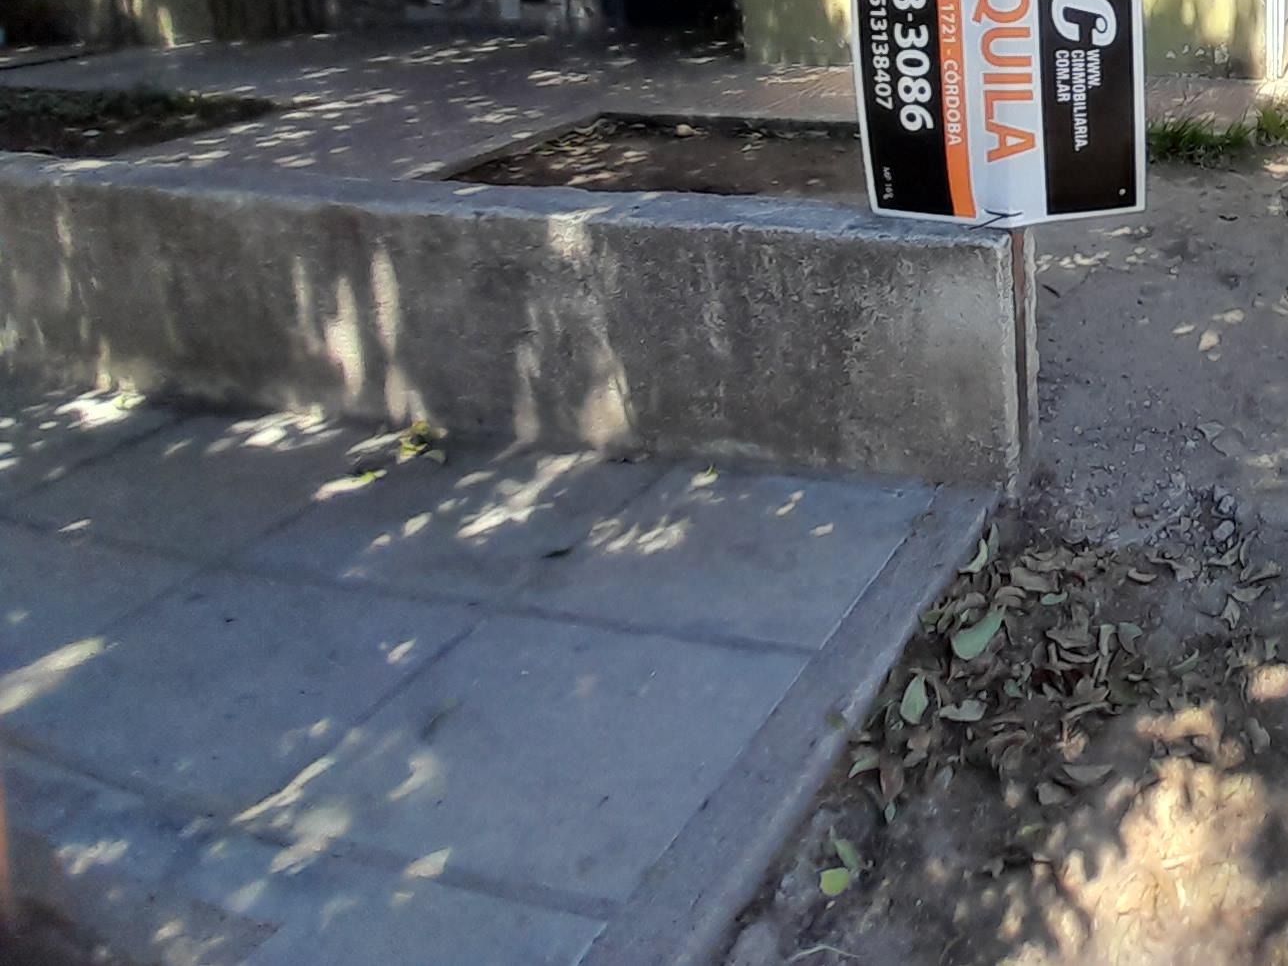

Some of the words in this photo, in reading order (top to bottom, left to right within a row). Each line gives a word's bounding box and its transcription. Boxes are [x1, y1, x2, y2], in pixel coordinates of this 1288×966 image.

[941, 5, 957, 43] 1721
[1055, 49, 1071, 102] COM.AR
[1087, 49, 1102, 89] WWW.
[944, 60, 963, 144] CÓRDOBA
[1071, 49, 1088, 151] CINMOBILIARIA.
